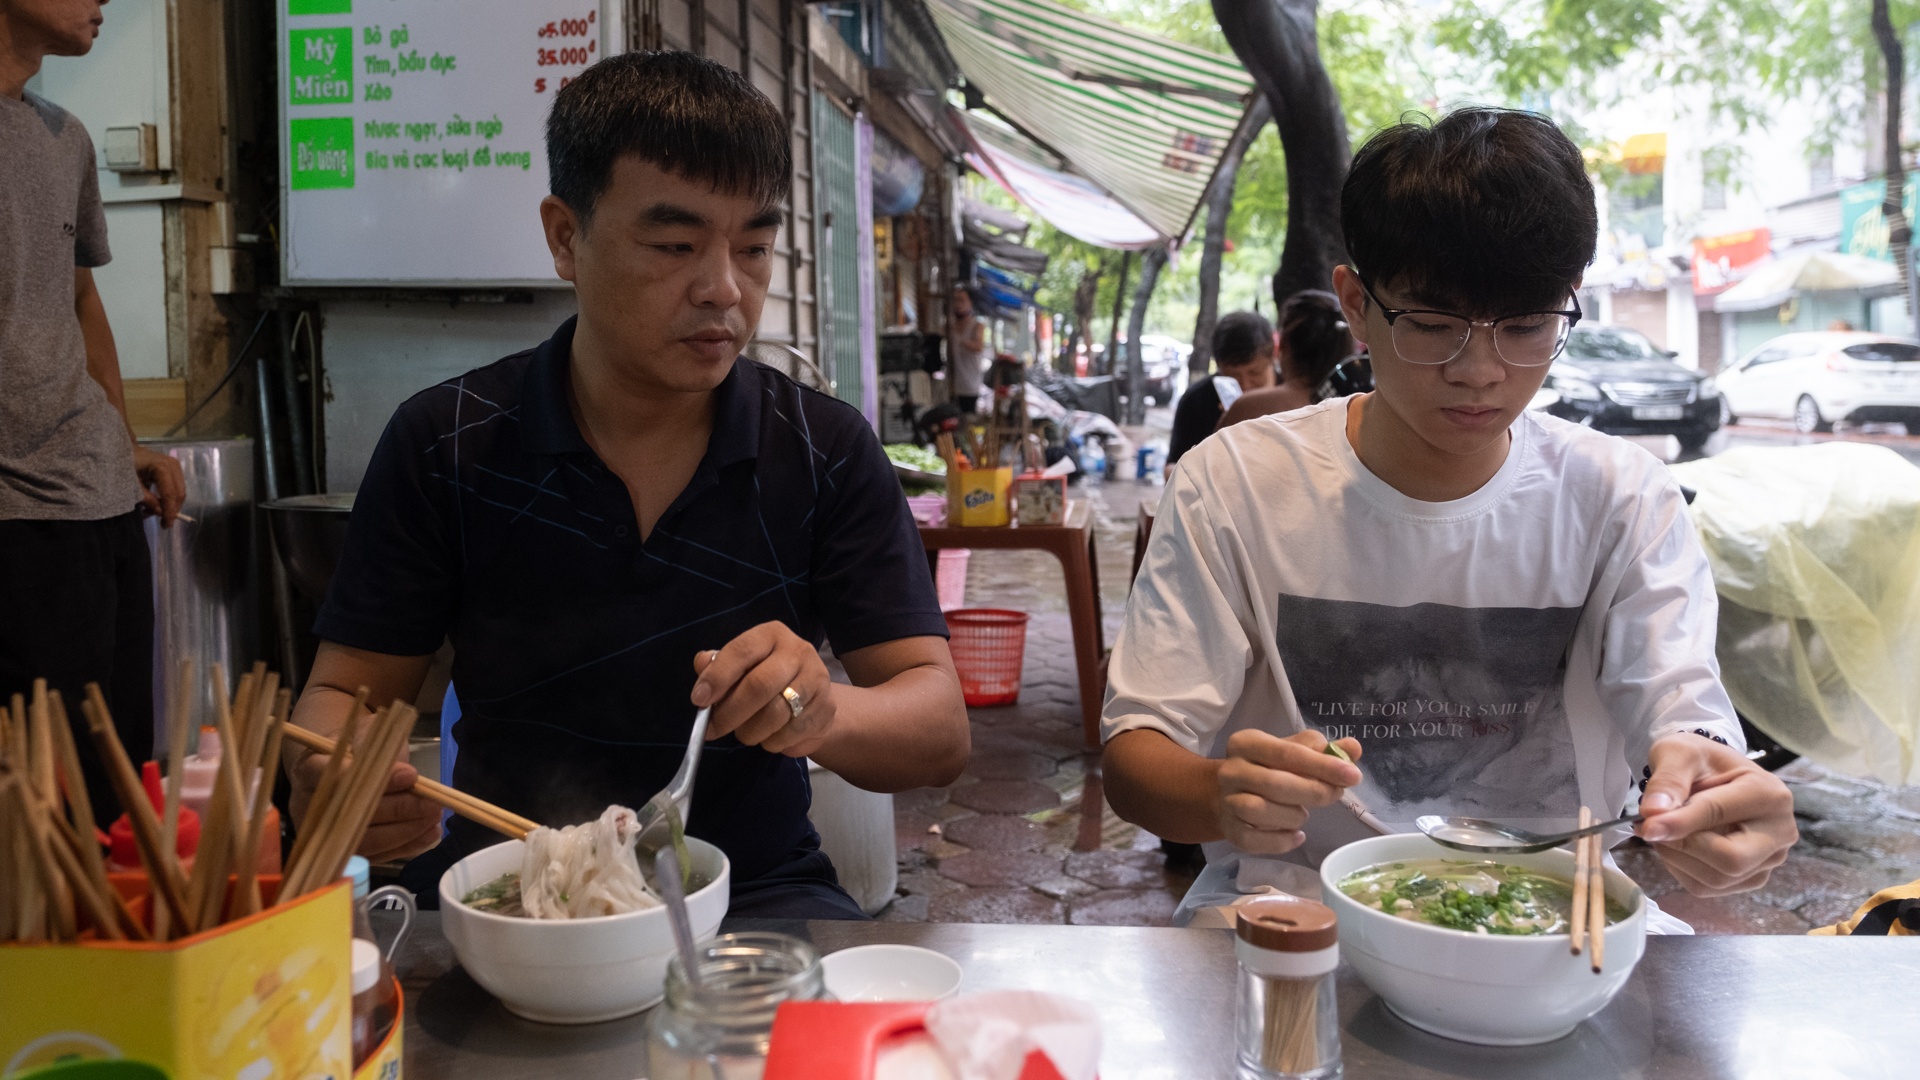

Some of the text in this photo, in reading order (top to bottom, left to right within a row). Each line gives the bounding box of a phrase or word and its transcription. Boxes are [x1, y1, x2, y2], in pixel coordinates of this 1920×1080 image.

[294, 69, 349, 99] Miến
[1369, 701, 1407, 717] FOR
[1415, 699, 1471, 718] YOUR
[1477, 701, 1536, 716] SMILE
[1325, 724, 1356, 740] DIE
[1362, 724, 1401, 739] FOR
[1408, 721, 1463, 738] YOUR
